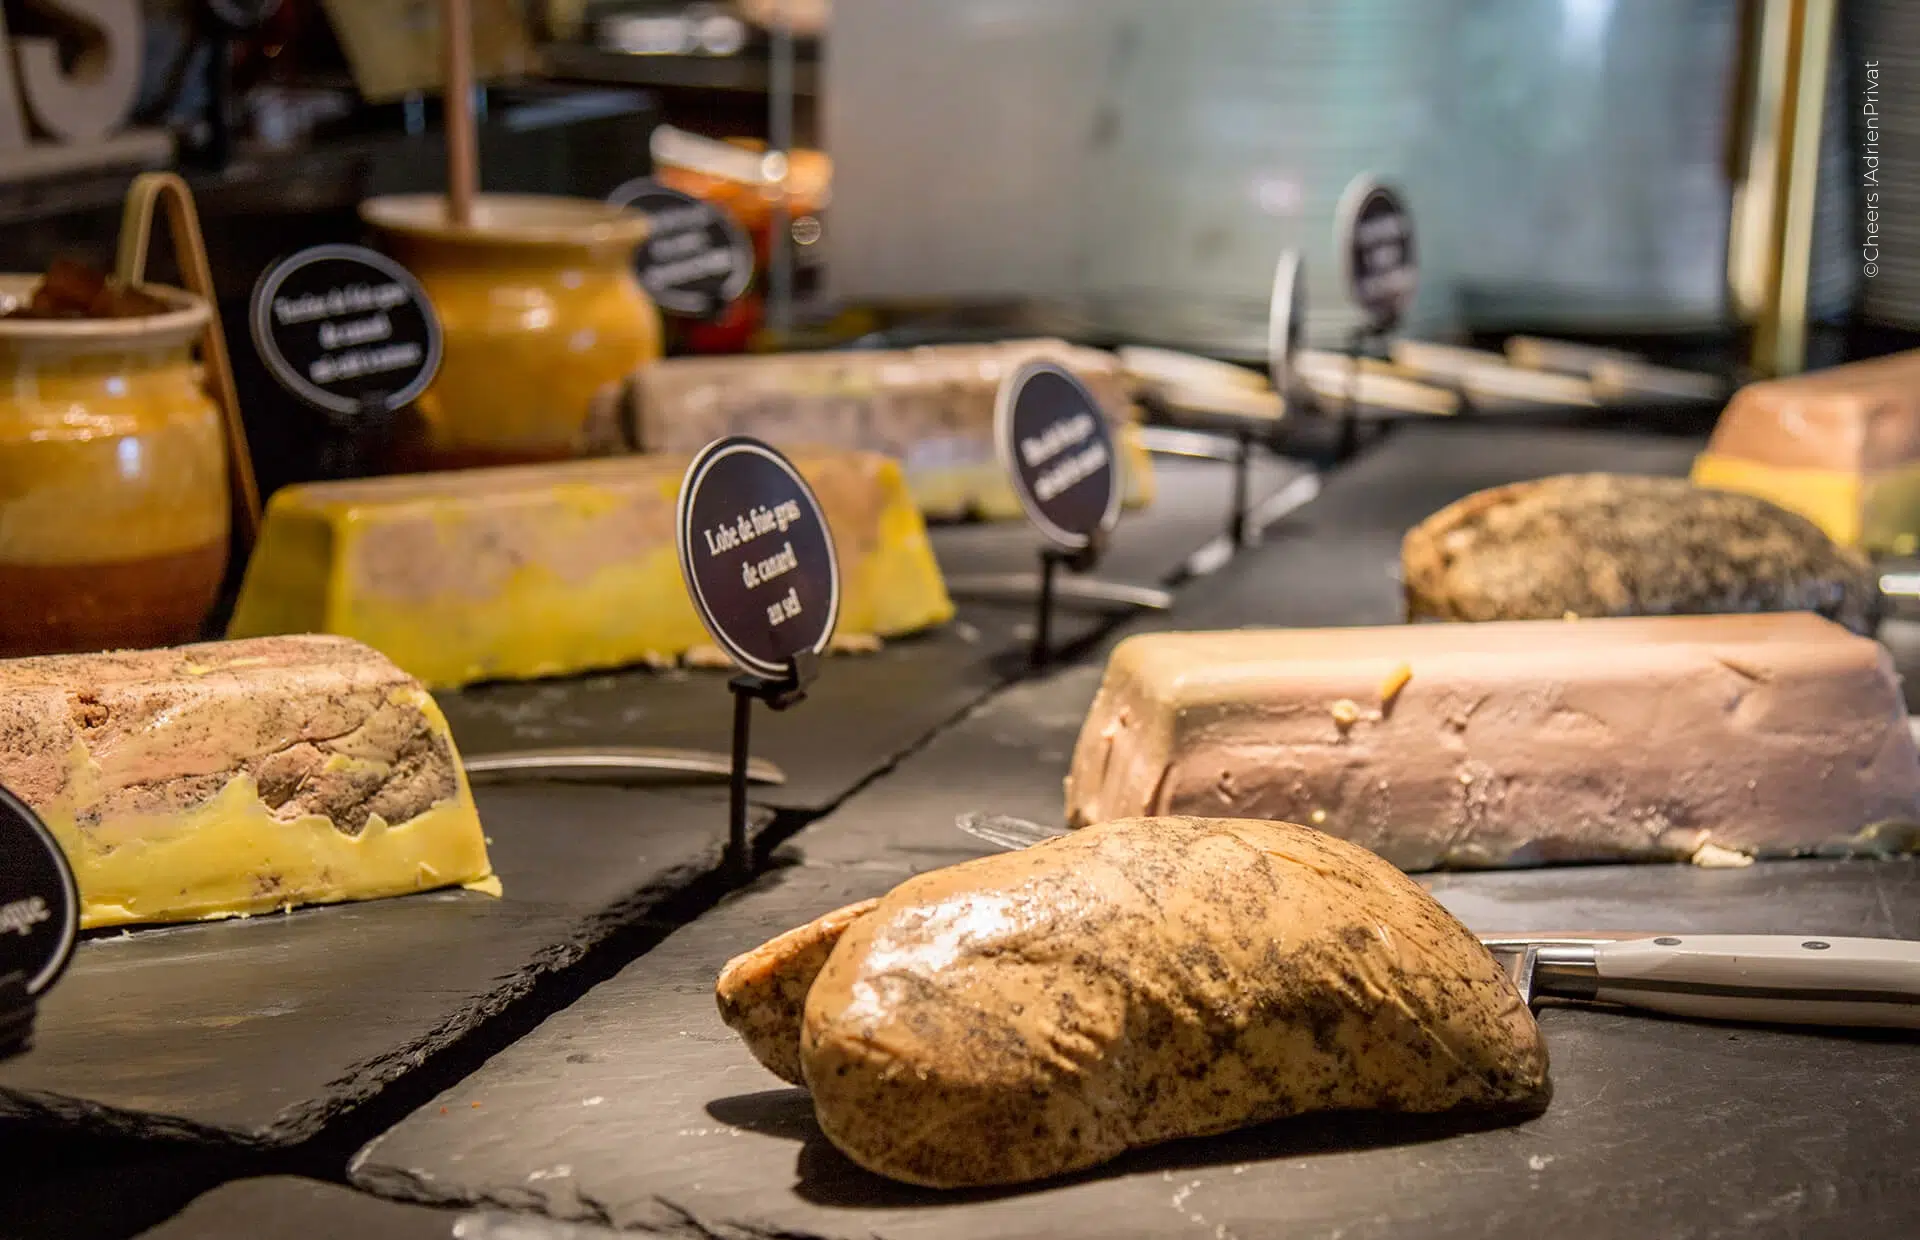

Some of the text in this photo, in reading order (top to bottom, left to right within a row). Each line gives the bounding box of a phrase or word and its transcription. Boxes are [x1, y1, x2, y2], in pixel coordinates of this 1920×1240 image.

[703, 498, 801, 556] Lobe de foie gras
[742, 541, 798, 590] de canard
[766, 587, 802, 627] au sel
